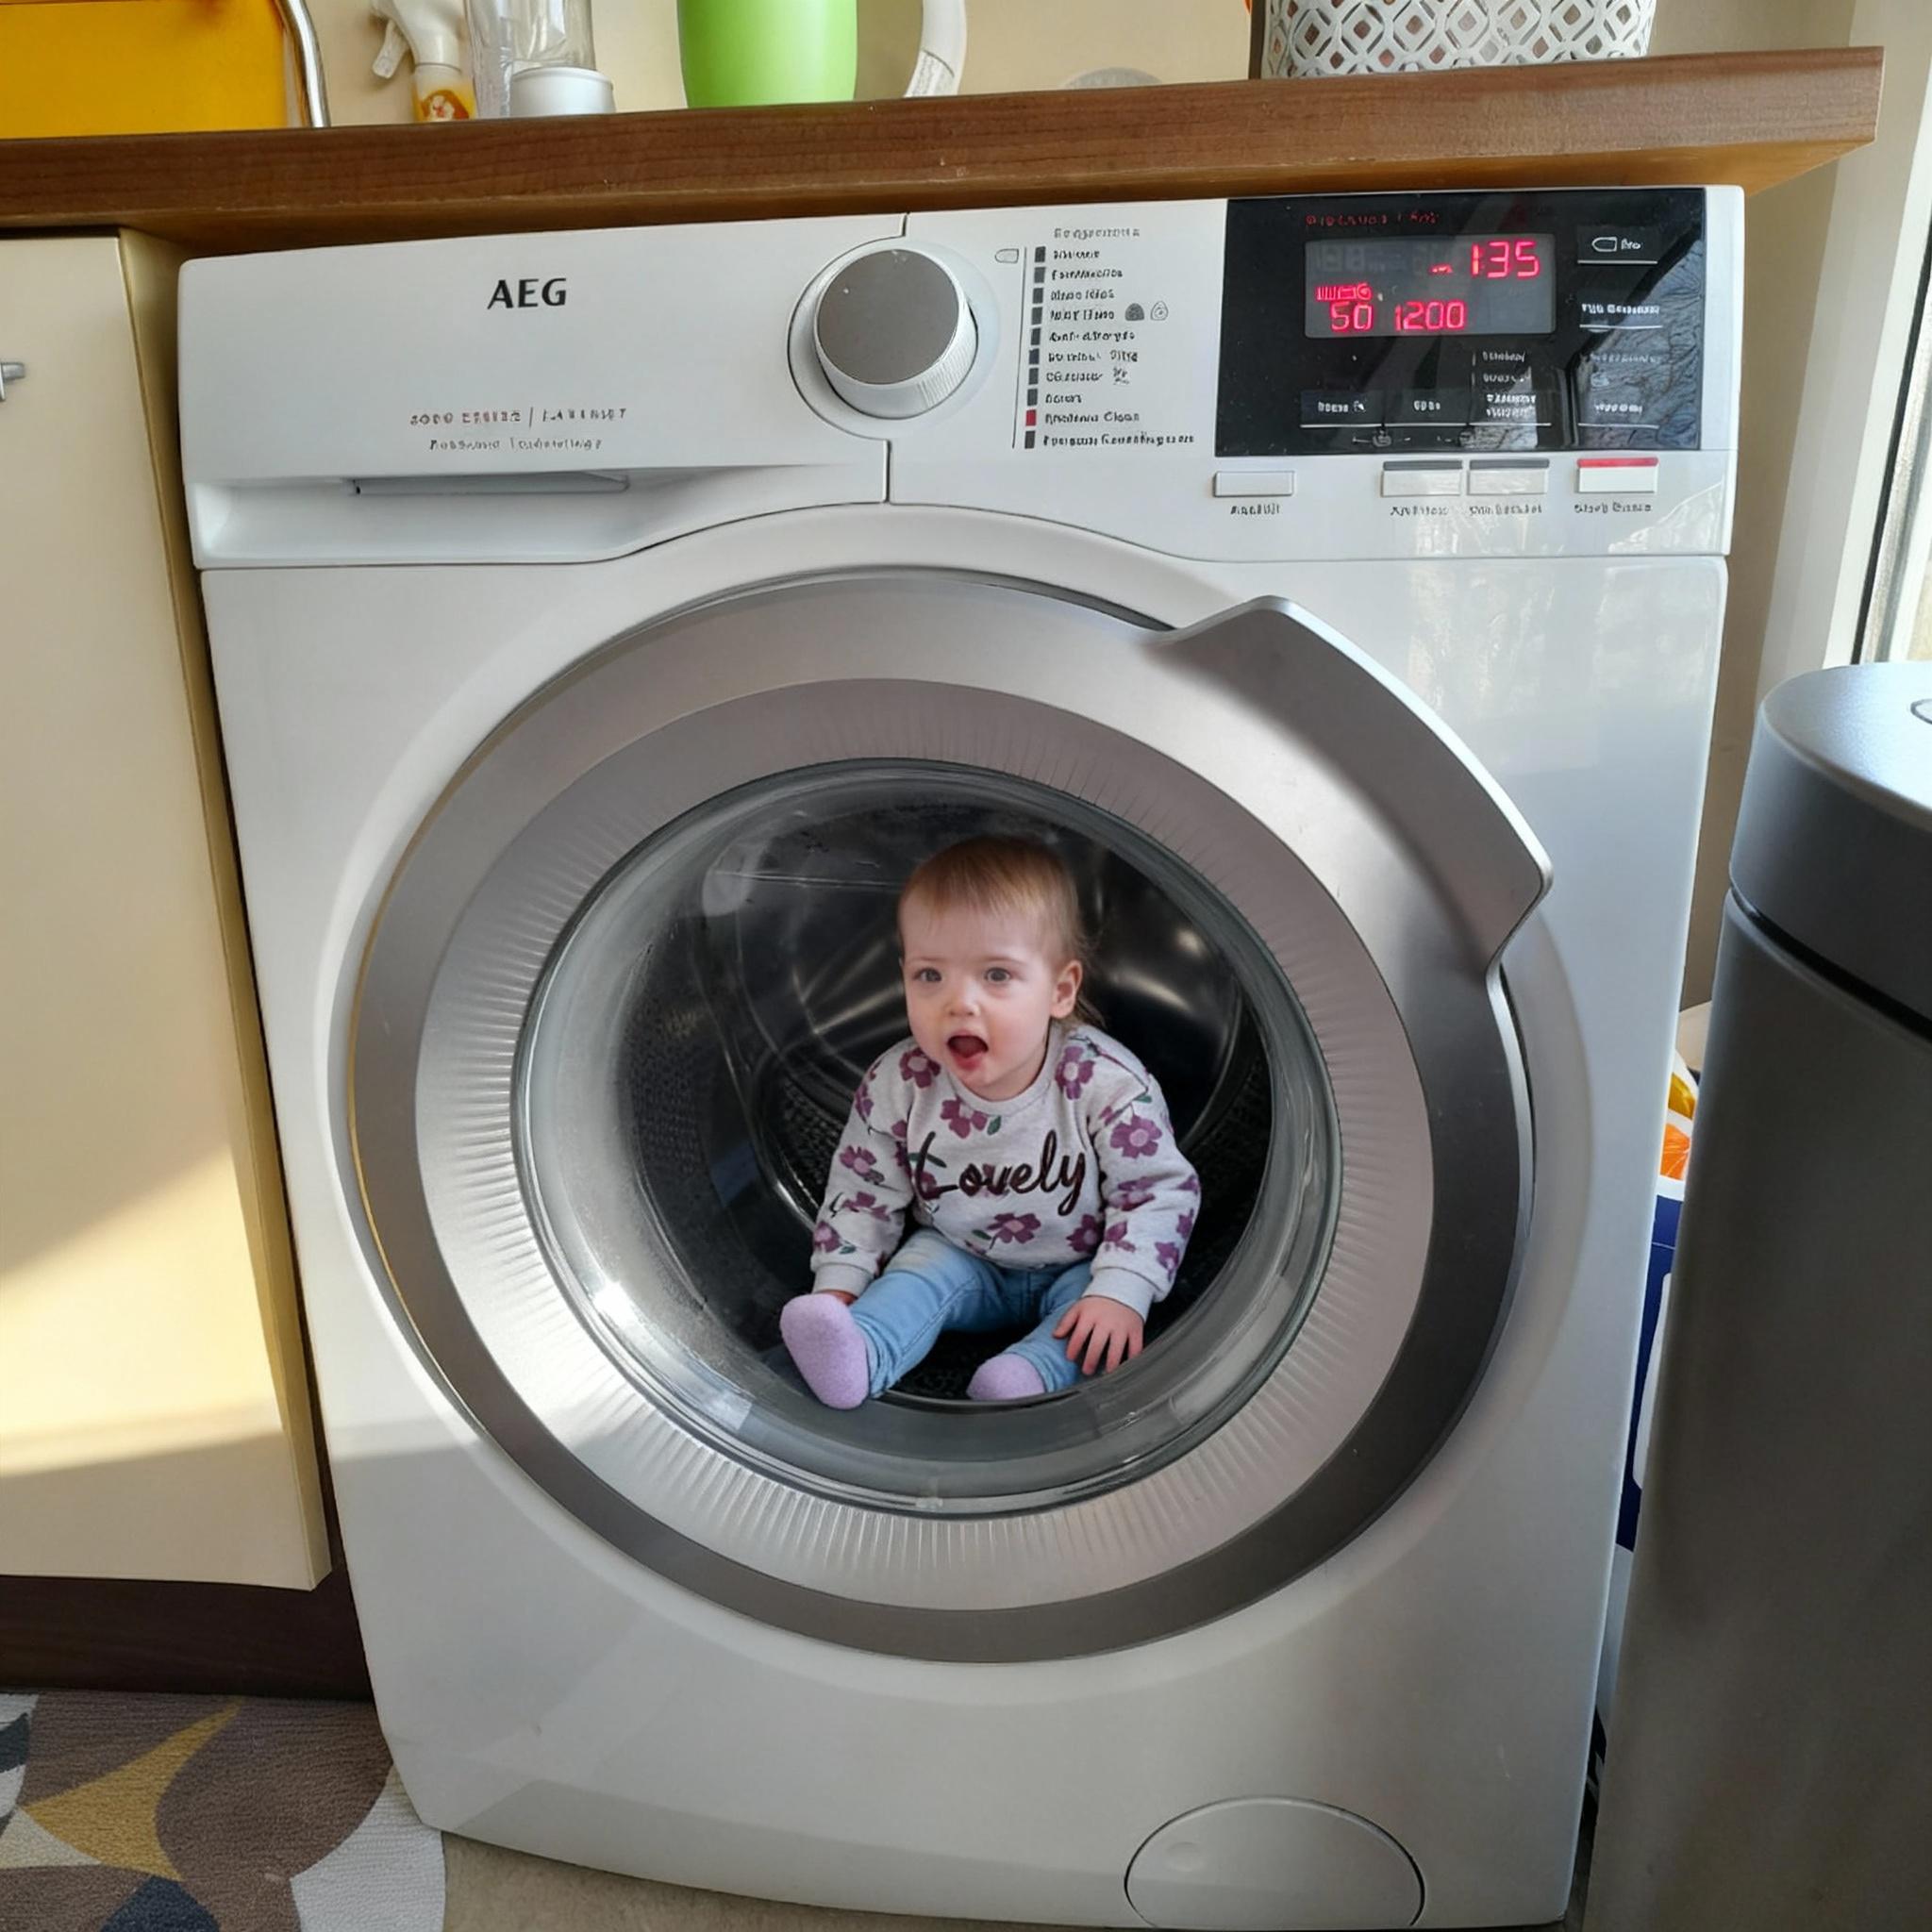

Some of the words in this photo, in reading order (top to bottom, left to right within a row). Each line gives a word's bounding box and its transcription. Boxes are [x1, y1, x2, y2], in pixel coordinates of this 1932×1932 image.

[487, 277, 567, 310] AEG
[1330, 301, 1373, 330] 50
[1395, 301, 1465, 331] 1200
[914, 1129, 1086, 1217] Lovely
